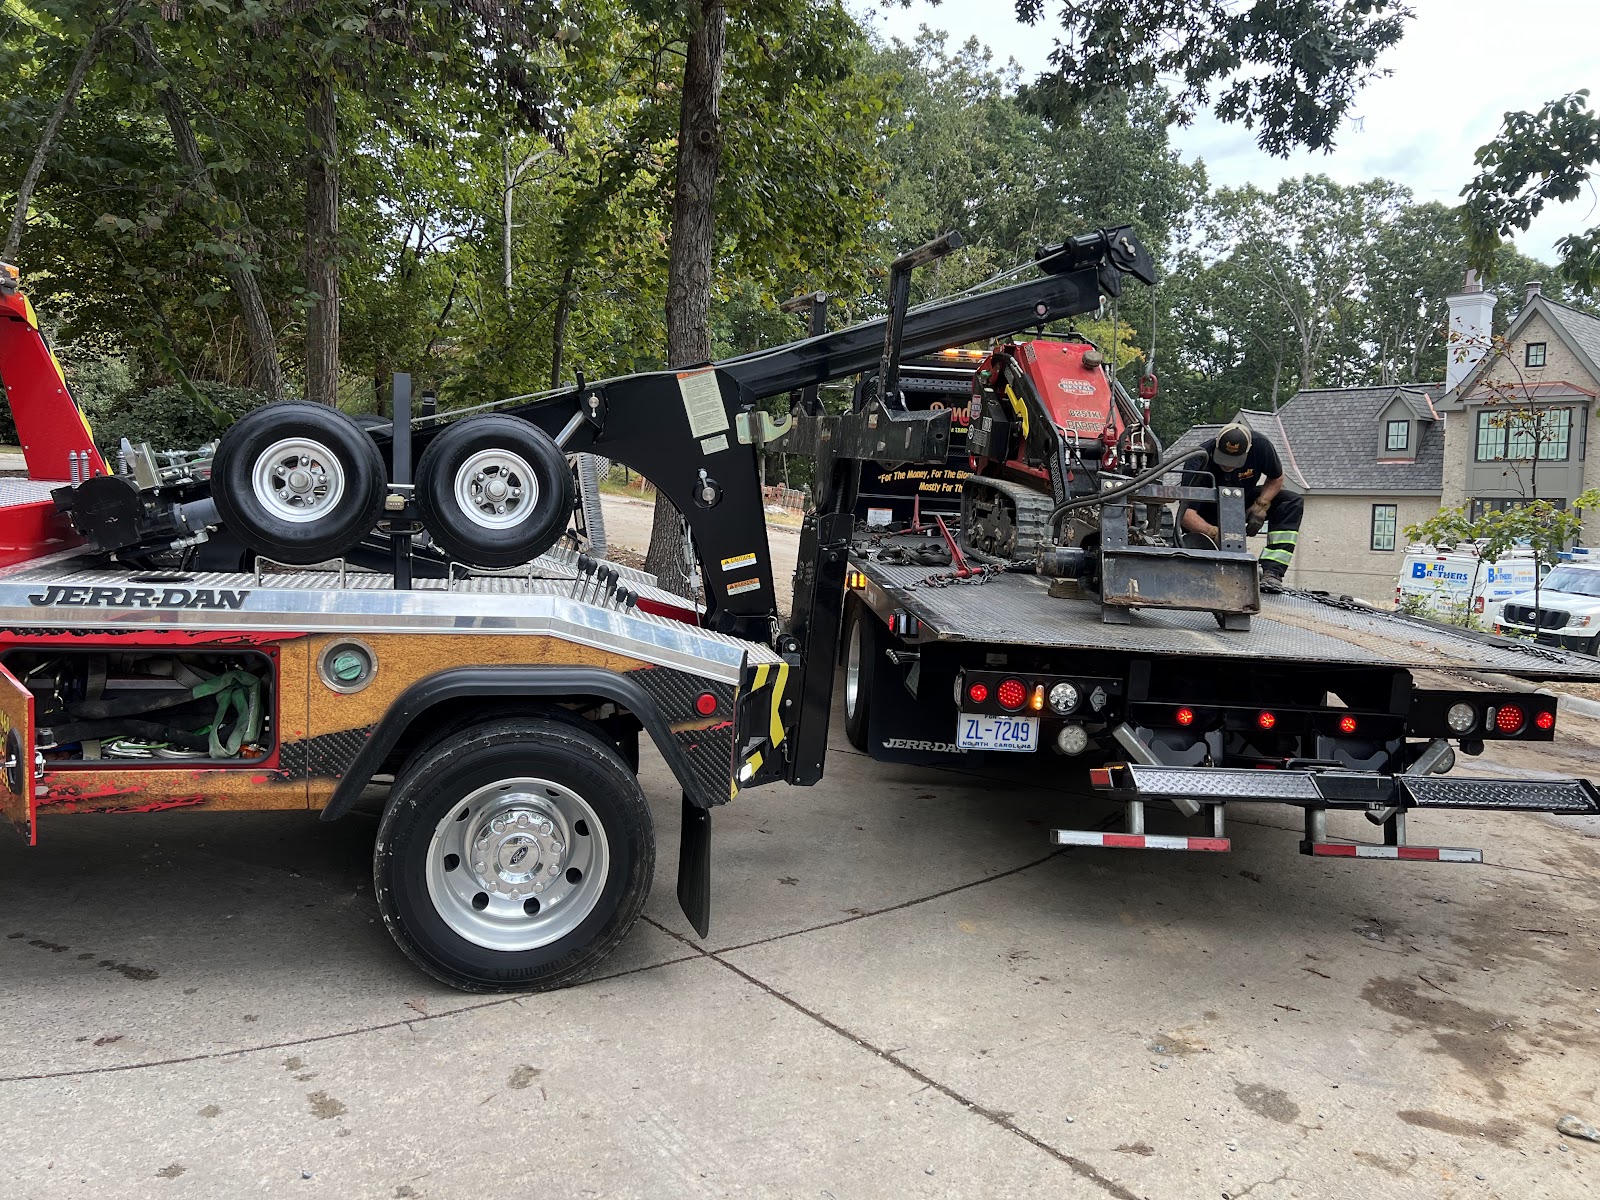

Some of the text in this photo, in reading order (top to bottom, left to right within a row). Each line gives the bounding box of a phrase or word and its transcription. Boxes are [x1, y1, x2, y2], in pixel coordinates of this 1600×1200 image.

[1066, 420, 1107, 432] BARRET
[894, 471, 906, 480] The
[907, 469, 930, 480] Money,
[931, 469, 942, 479] For
[944, 470, 957, 479] The
[919, 482, 964, 493] Mostly For Th
[28, 585, 251, 610] JERR-DAN
[966, 719, 1030, 742] ZL-7249
